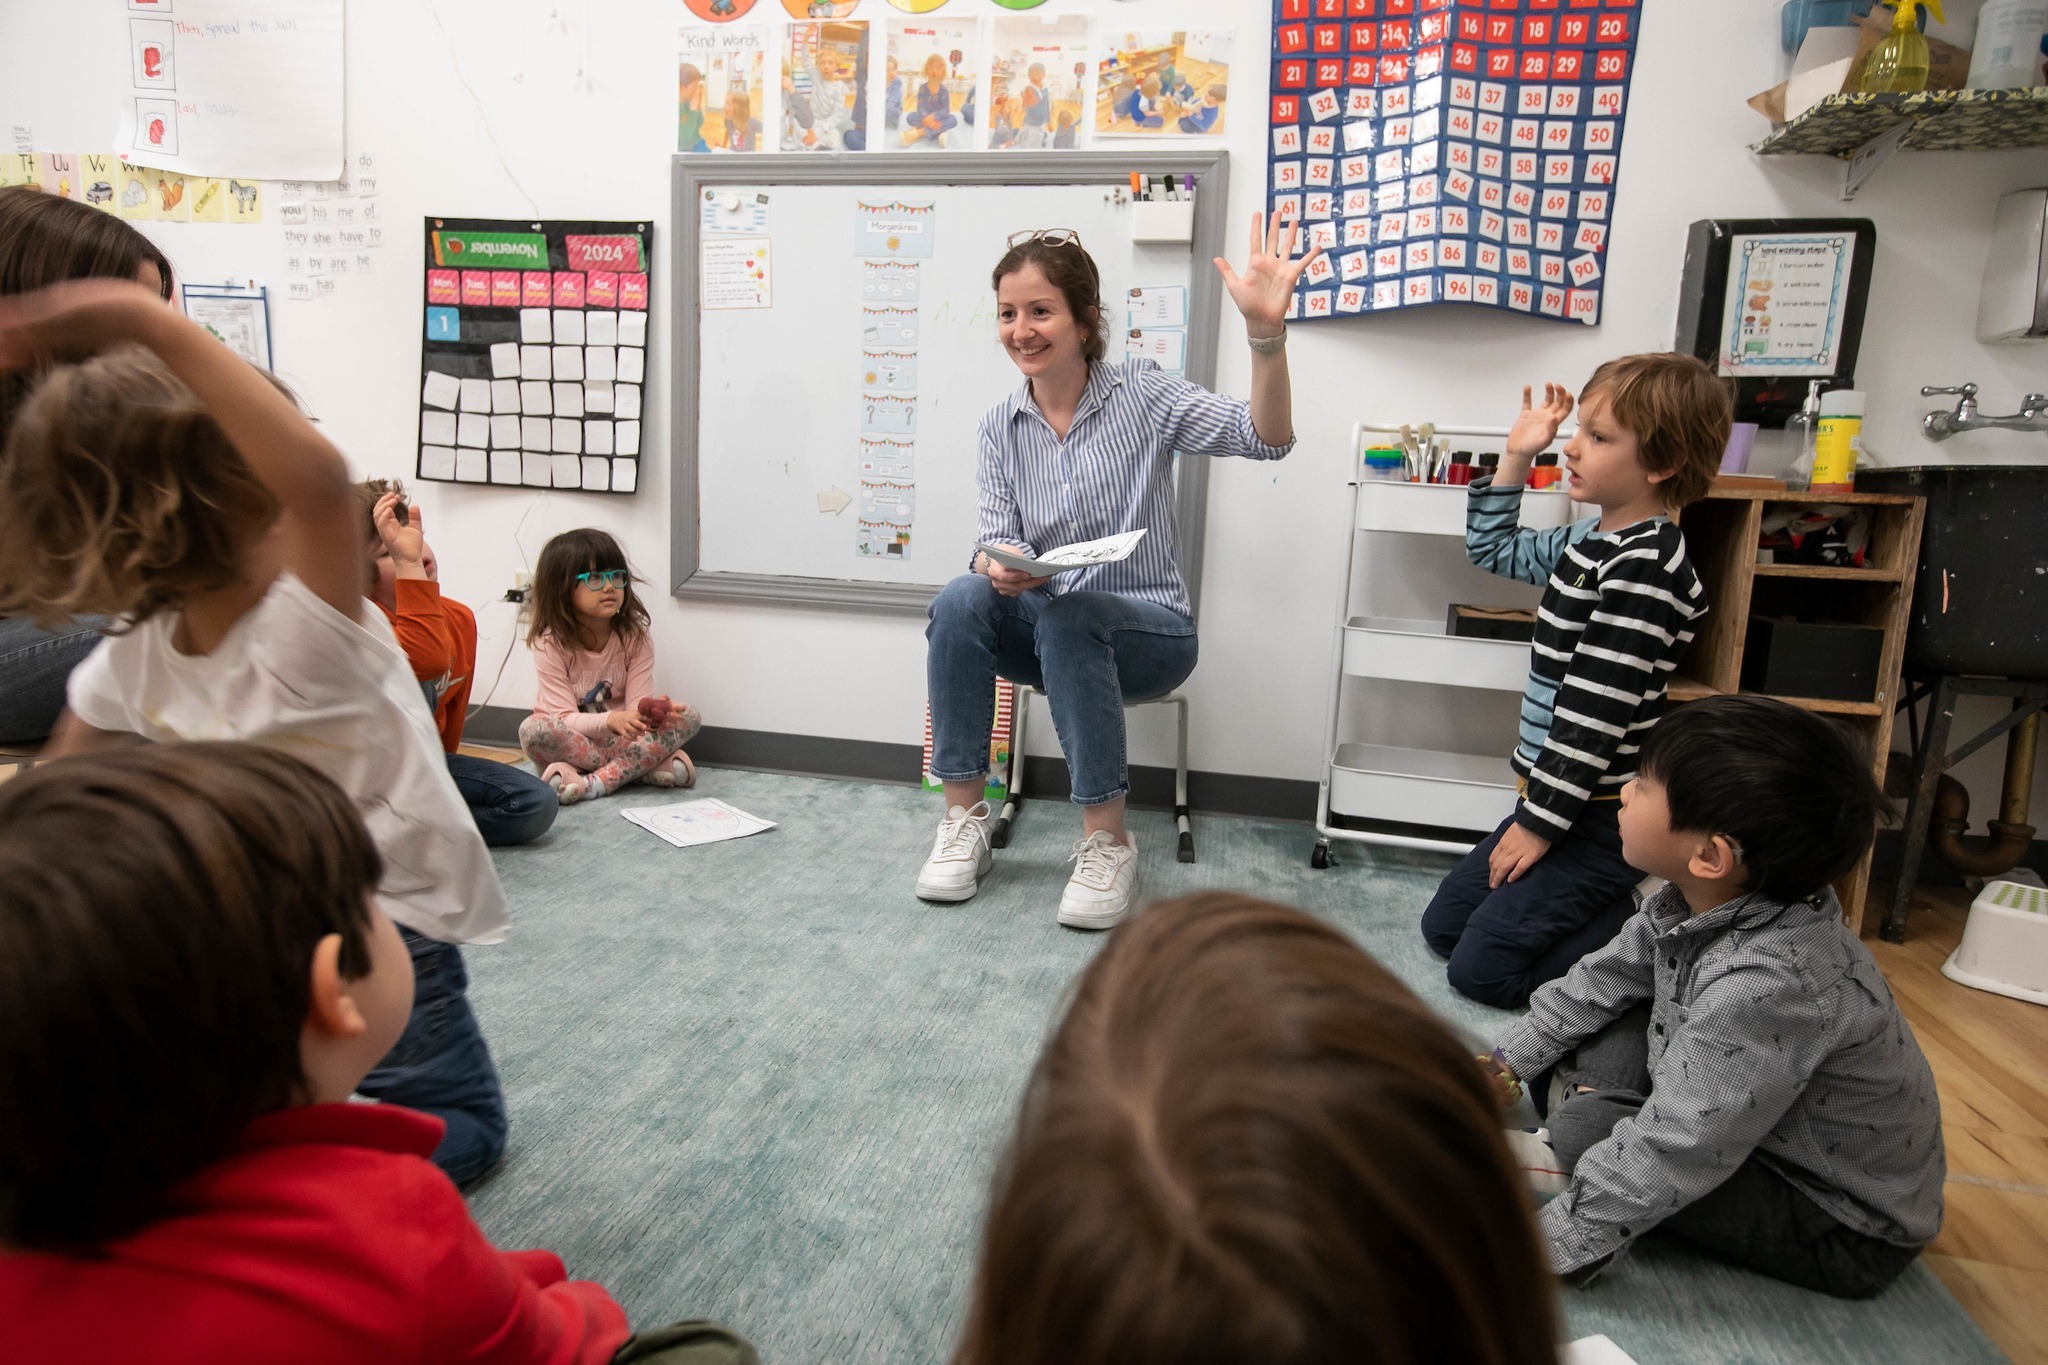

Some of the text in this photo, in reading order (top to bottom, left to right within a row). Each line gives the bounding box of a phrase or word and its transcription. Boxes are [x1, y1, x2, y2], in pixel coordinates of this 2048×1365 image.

[1287, 30, 1298, 45] 11
[1320, 31, 1334, 45] 12
[1356, 29, 1370, 44] 13
[1464, 18, 1478, 34] 16
[1492, 21, 1507, 37] 17
[1529, 22, 1544, 38] 18
[1566, 21, 1582, 37] 19
[1601, 20, 1621, 35] 20
[1287, 66, 1300, 81] 21
[1321, 65, 1338, 81] 22
[1352, 62, 1370, 78] 23
[1455, 49, 1472, 65] 26
[1493, 56, 1509, 71] 27
[1525, 58, 1543, 73] 28
[1557, 57, 1576, 73] 29
[1599, 57, 1620, 73] 30
[1278, 102, 1292, 117] 31
[1316, 96, 1334, 113] 32
[1354, 95, 1370, 109] 33
[1387, 94, 1405, 108] 34
[1456, 85, 1471, 100] 36
[1484, 89, 1501, 104] 37
[1525, 93, 1542, 107] 38
[1555, 93, 1574, 108] 39
[1598, 93, 1619, 108] 40
[1281, 133, 1295, 147] 41
[1313, 133, 1330, 147] 42
[1453, 116, 1469, 131] 46
[1482, 121, 1498, 135] 47
[1517, 127, 1534, 141] 48
[1548, 128, 1567, 142] 49
[1590, 128, 1610, 143] 50
[52, 154, 69, 172] Uu
[359, 154, 373, 167] do
[1282, 168, 1295, 181] 51
[1312, 165, 1328, 179] 52
[1347, 163, 1364, 176] 53
[1452, 149, 1468, 164] 56
[1483, 155, 1498, 169] 57
[1516, 160, 1532, 173] 58
[1550, 162, 1568, 176] 59
[1591, 162, 1611, 177] 60
[283, 182, 303, 191] one
[360, 178, 377, 189] my
[1282, 201, 1295, 214] 61
[1350, 196, 1364, 209] 63
[1416, 180, 1433, 197] 65
[1452, 177, 1467, 193] 66
[1484, 187, 1498, 201] 67
[1513, 192, 1530, 206] 68
[1547, 196, 1564, 211] 69
[1584, 198, 1602, 212] 70
[281, 204, 375, 218] you his me of
[285, 228, 381, 243] they she have to
[1352, 225, 1366, 238] 73
[1384, 220, 1400, 234] 74
[1415, 214, 1430, 227] 75
[1448, 213, 1464, 227] 76
[1486, 217, 1499, 232] 77
[1513, 224, 1527, 238] 78
[1543, 229, 1558, 243] 79
[1581, 228, 1600, 244] 80
[289, 255, 370, 270] as by are he
[470, 241, 624, 262] November 2024
[1311, 260, 1327, 276] 82
[1443, 246, 1461, 260] 86
[1481, 250, 1496, 265] 87
[1512, 255, 1527, 269] 88
[1545, 262, 1560, 276] 89
[1574, 261, 1594, 278] 90
[290, 279, 335, 293] was has
[1310, 297, 1326, 311] 92
[1343, 291, 1359, 306] 93
[1410, 283, 1426, 297] 95
[1450, 281, 1467, 295] 96
[1478, 283, 1492, 297] 97
[1514, 290, 1528, 304] 98
[1545, 294, 1560, 309] 99
[1573, 298, 1593, 312] 100
[440, 315, 448, 332] 1
